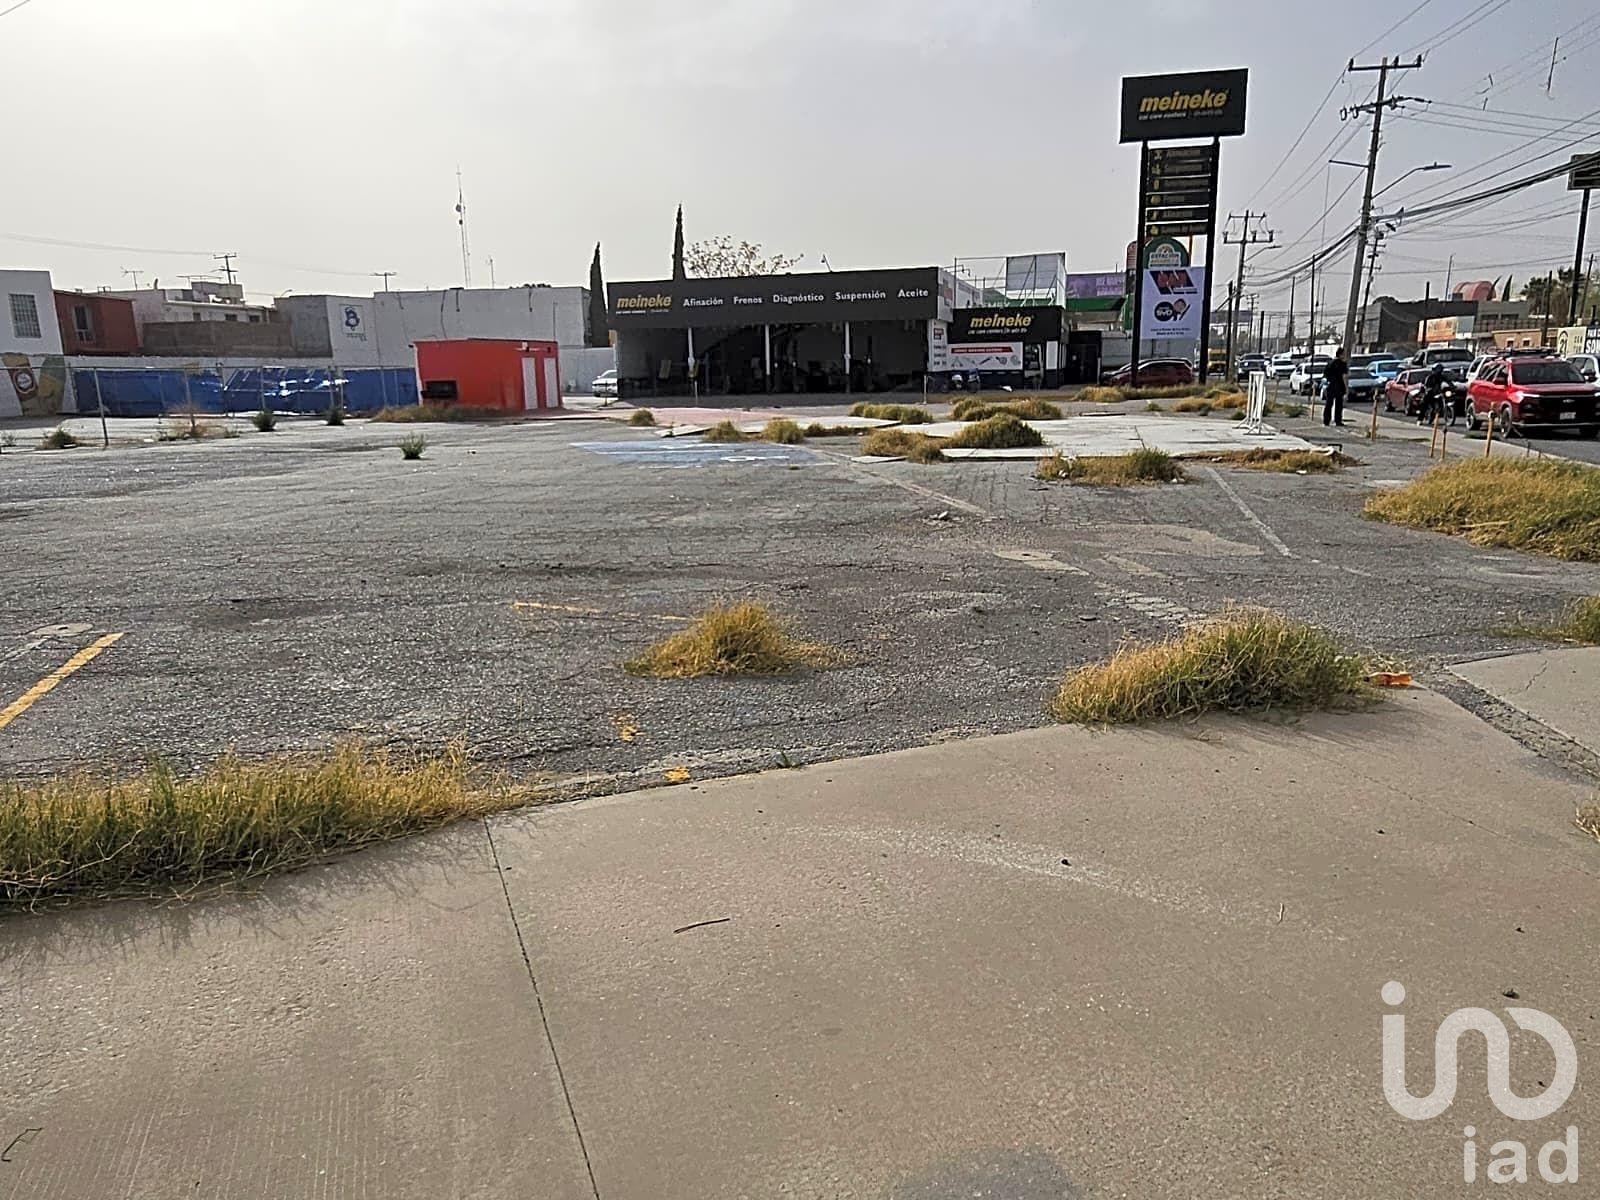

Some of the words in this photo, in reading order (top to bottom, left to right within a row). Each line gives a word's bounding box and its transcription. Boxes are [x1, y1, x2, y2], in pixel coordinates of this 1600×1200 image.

[1139, 88, 1229, 112] meineke
[616, 294, 672, 308] meineke
[683, 298, 723, 307] Afinación
[733, 296, 762, 305] Frenos
[773, 293, 824, 304] Diagnóstico
[835, 290, 886, 302] Suspensión
[898, 288, 928, 298] Aceite
[969, 313, 1032, 327] meineke
